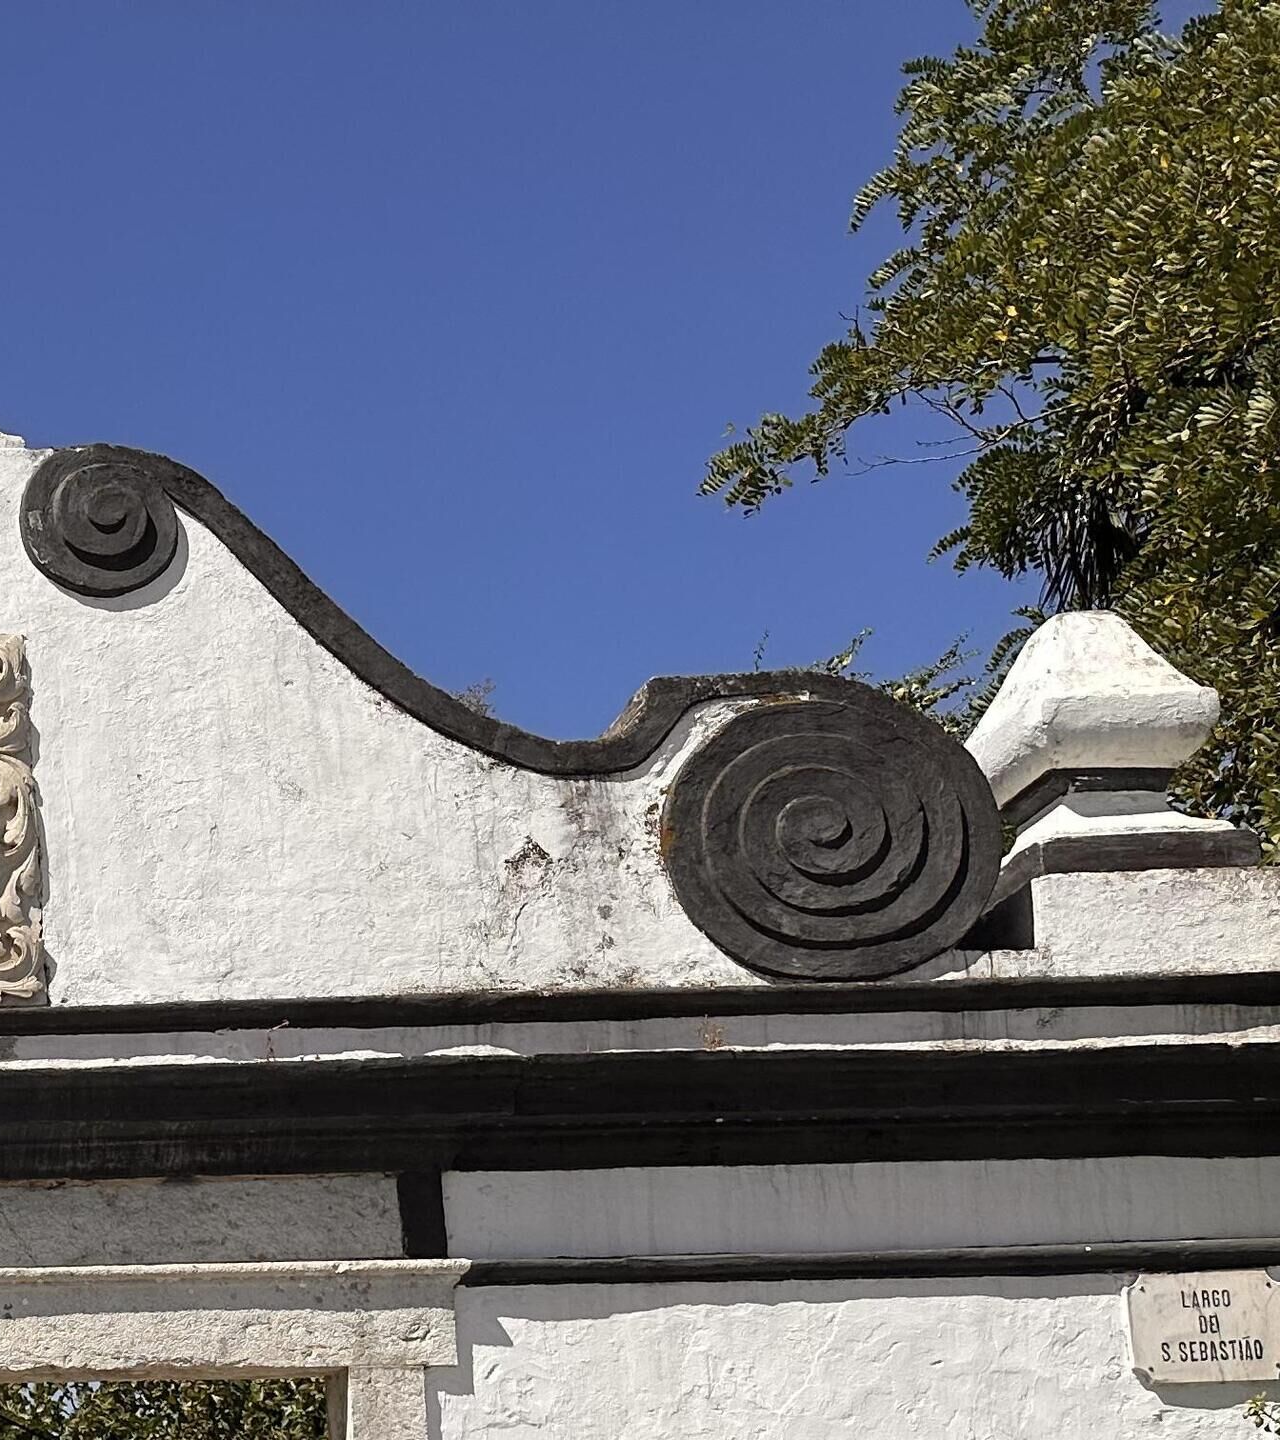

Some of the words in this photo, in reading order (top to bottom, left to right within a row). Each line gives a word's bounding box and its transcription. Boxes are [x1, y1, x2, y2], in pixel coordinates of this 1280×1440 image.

[1180, 1289, 1231, 1309] LARGO
[1161, 1342, 1176, 1363] S.
[1178, 1336, 1264, 1362] SEBASTIÃO
